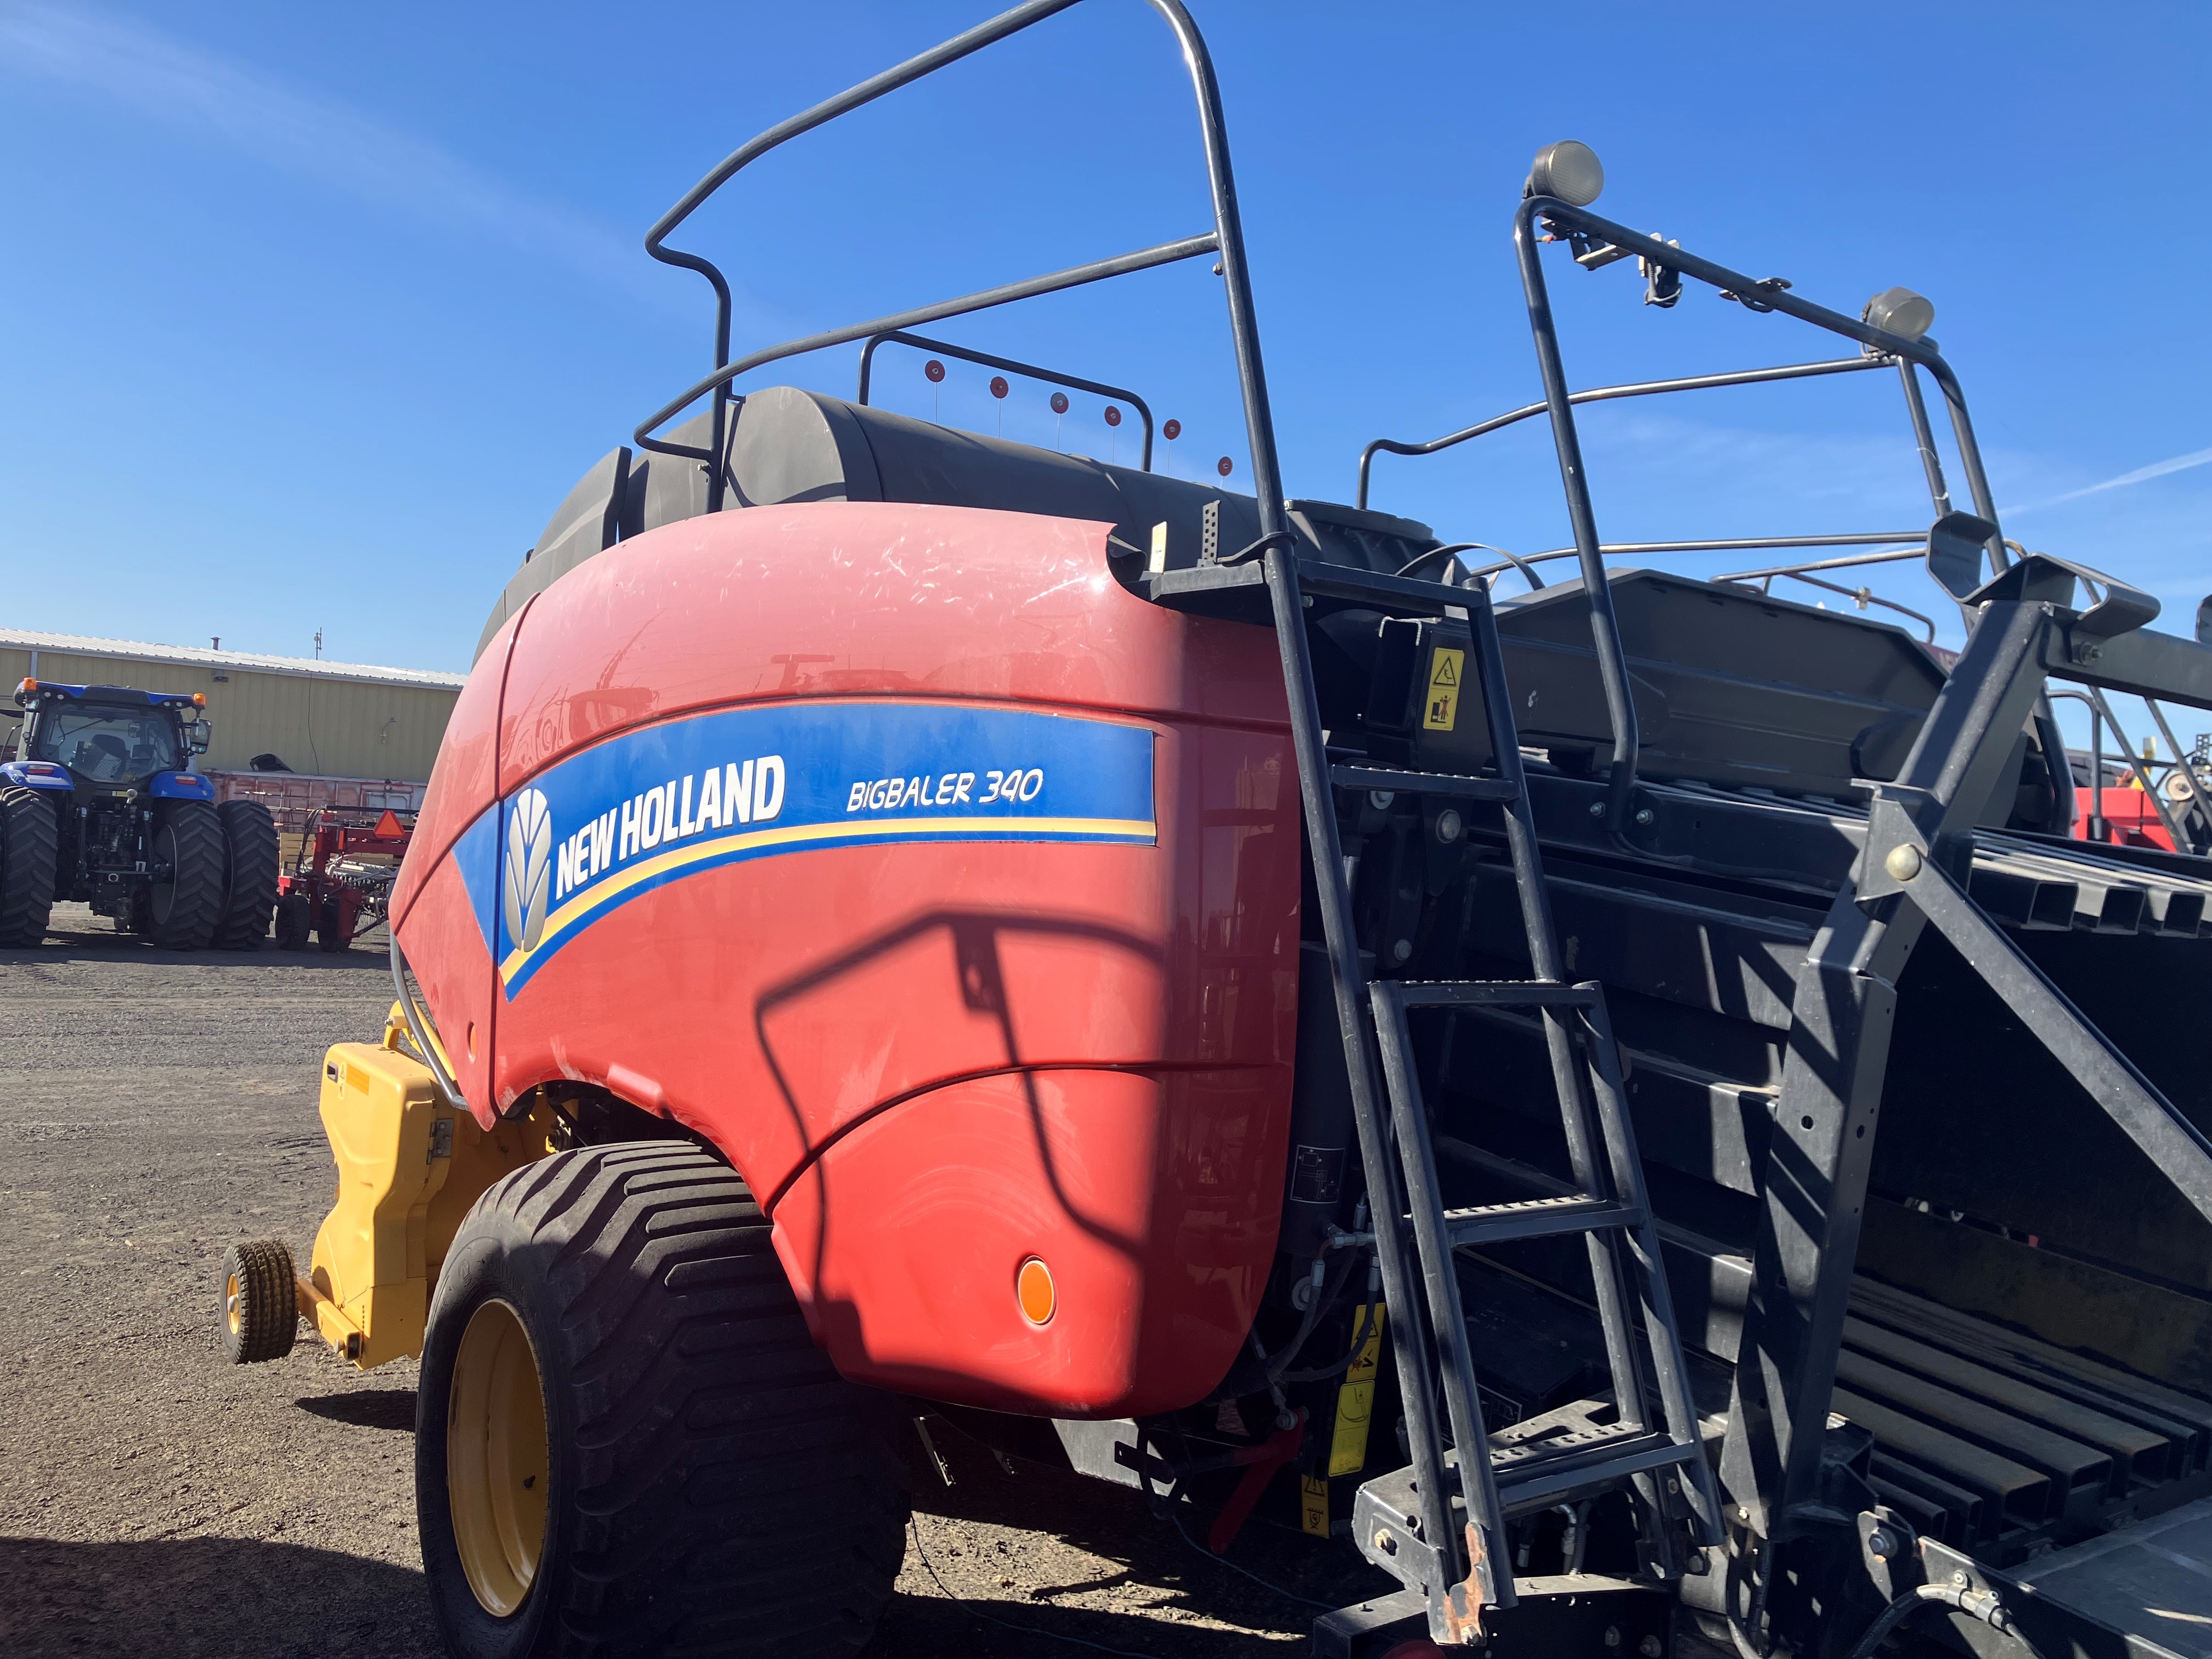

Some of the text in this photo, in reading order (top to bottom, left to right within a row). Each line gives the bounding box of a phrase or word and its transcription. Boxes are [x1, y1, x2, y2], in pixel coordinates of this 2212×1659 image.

[556, 755, 786, 901] NEW HOLLAND
[847, 768, 1043, 812] BIGBALER 340
